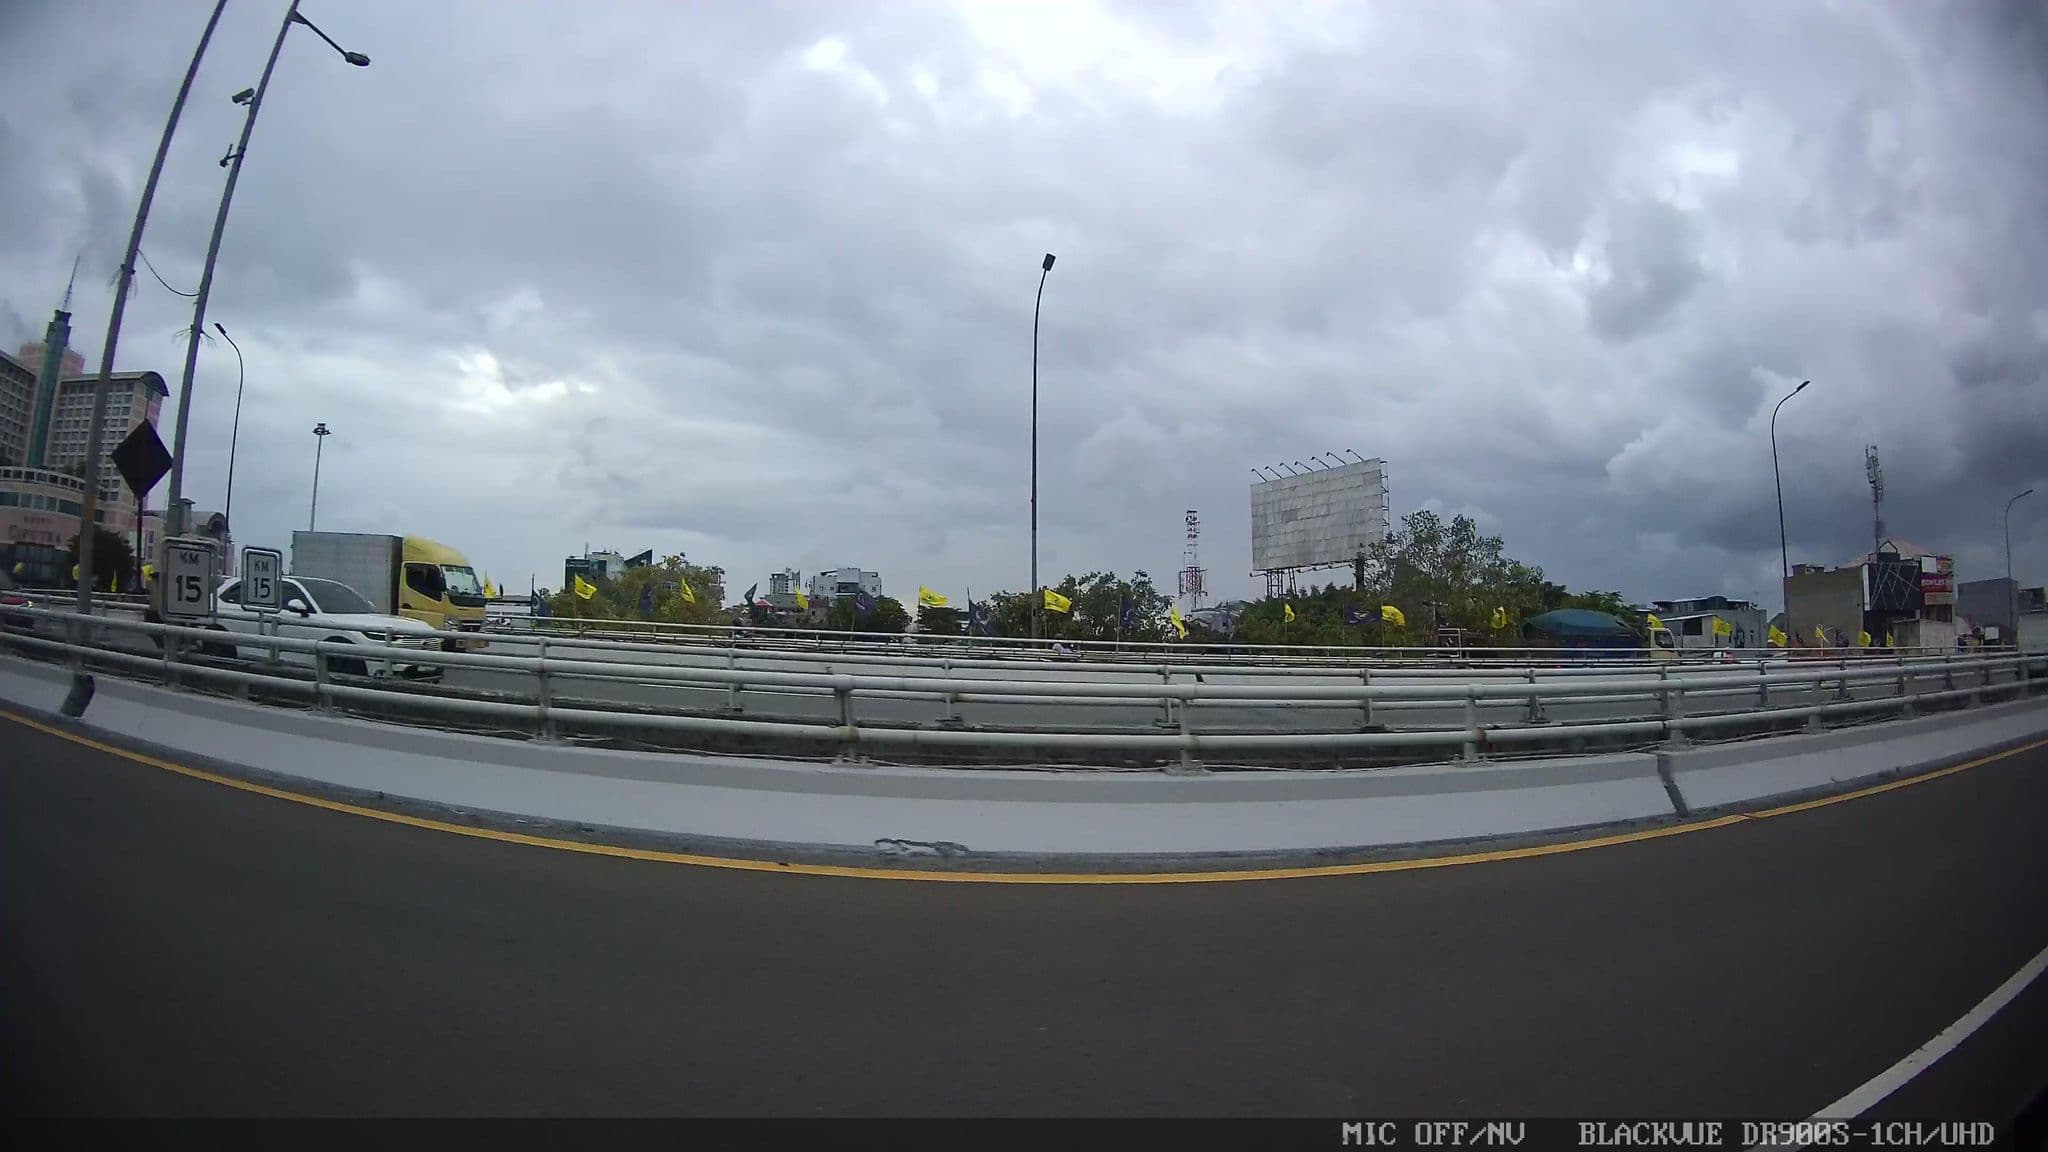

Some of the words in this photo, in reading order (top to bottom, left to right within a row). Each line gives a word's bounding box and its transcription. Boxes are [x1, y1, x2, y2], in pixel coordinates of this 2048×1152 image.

[179, 550, 200, 566] KM
[254, 559, 269, 573] KM
[175, 575, 203, 603] 15
[253, 577, 271, 599] 15
